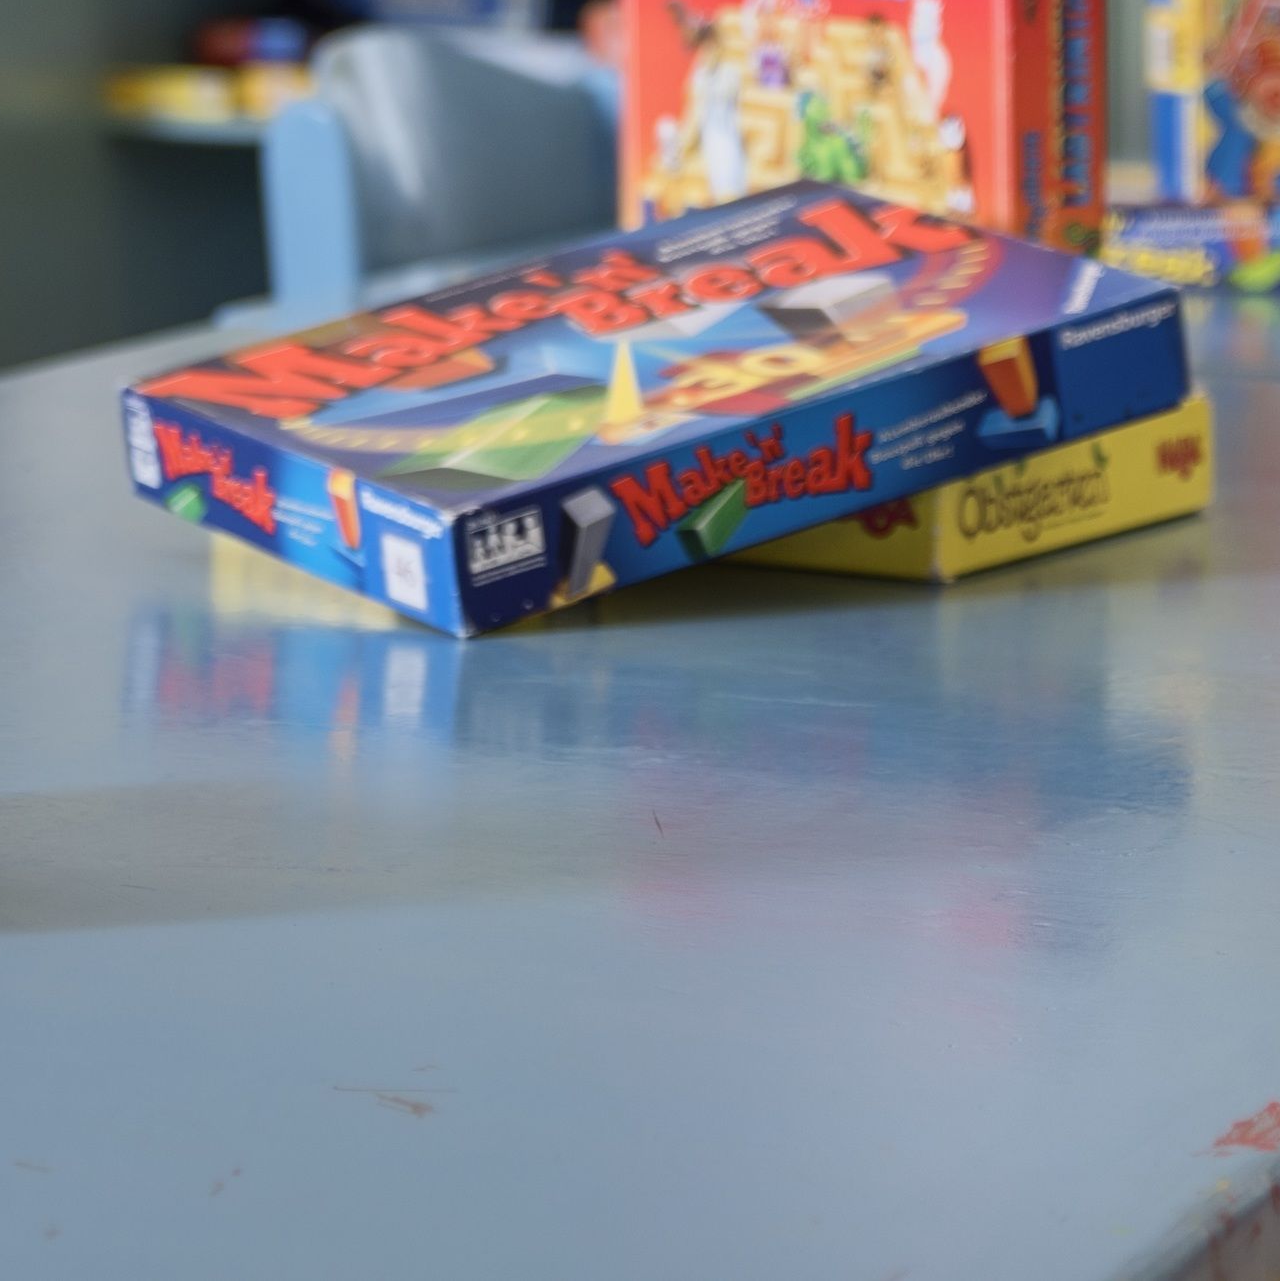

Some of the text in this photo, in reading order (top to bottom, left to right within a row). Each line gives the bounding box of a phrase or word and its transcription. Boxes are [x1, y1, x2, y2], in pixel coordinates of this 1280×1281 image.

[549, 198, 970, 335] Break
[612, 445, 747, 547] Make
[743, 413, 875, 508] Break
